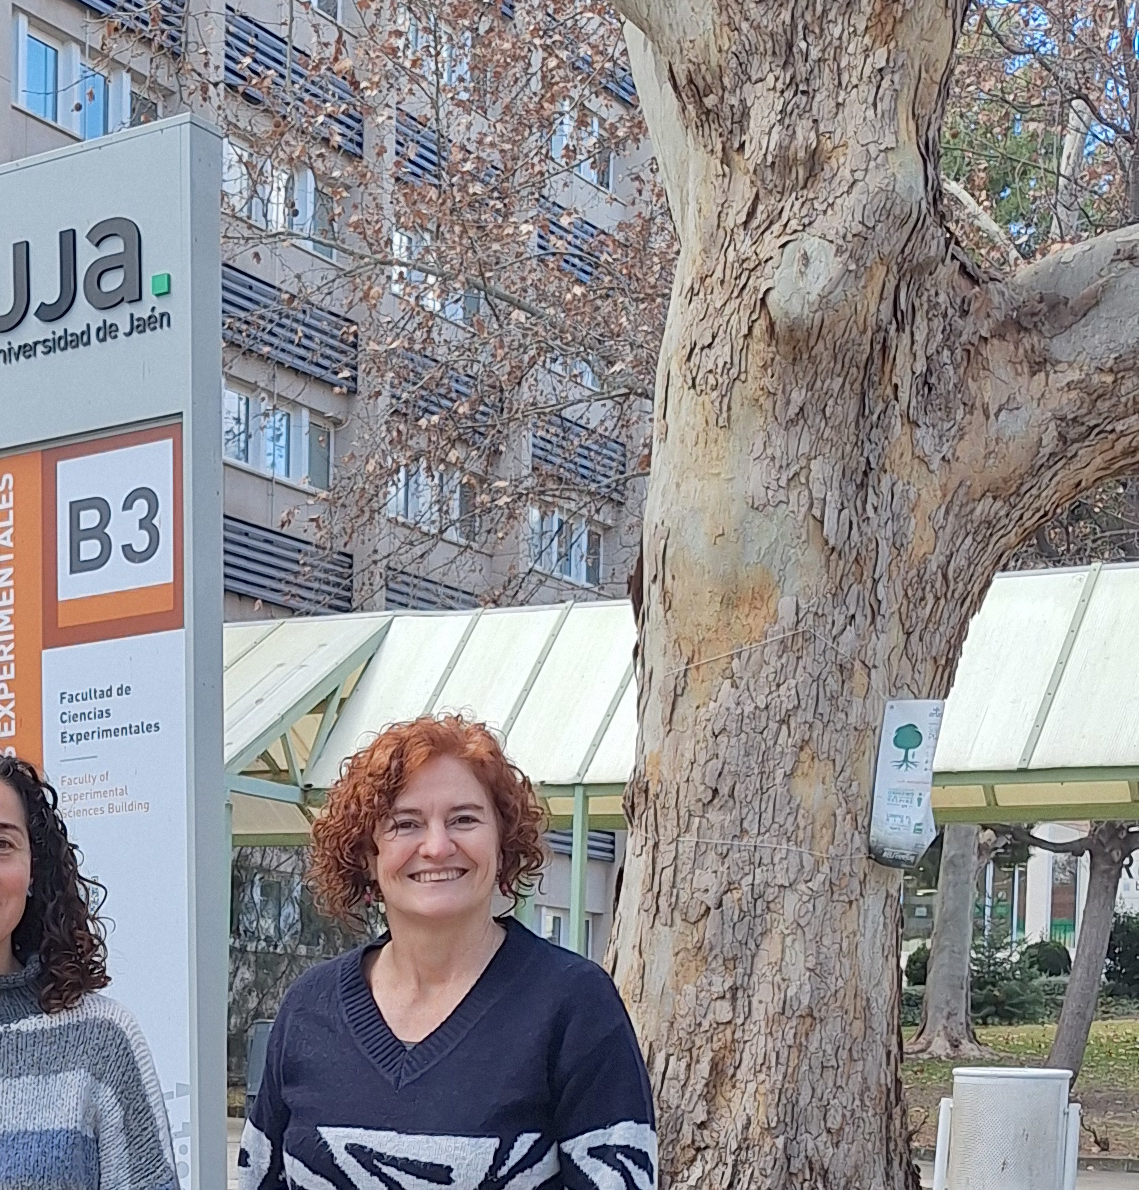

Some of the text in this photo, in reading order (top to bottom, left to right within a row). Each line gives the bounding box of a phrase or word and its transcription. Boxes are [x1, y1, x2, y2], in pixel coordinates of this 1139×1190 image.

[96, 319, 120, 343] de
[123, 306, 171, 338] Jaén
[68, 486, 160, 575] B3
[60, 684, 132, 705] Facultad de
[60, 707, 112, 724] Ciencias
[60, 721, 161, 745] Experimentales
[61, 770, 110, 787] Faculty of
[61, 785, 129, 803] Experimental
[62, 801, 150, 819] Sciences Building
